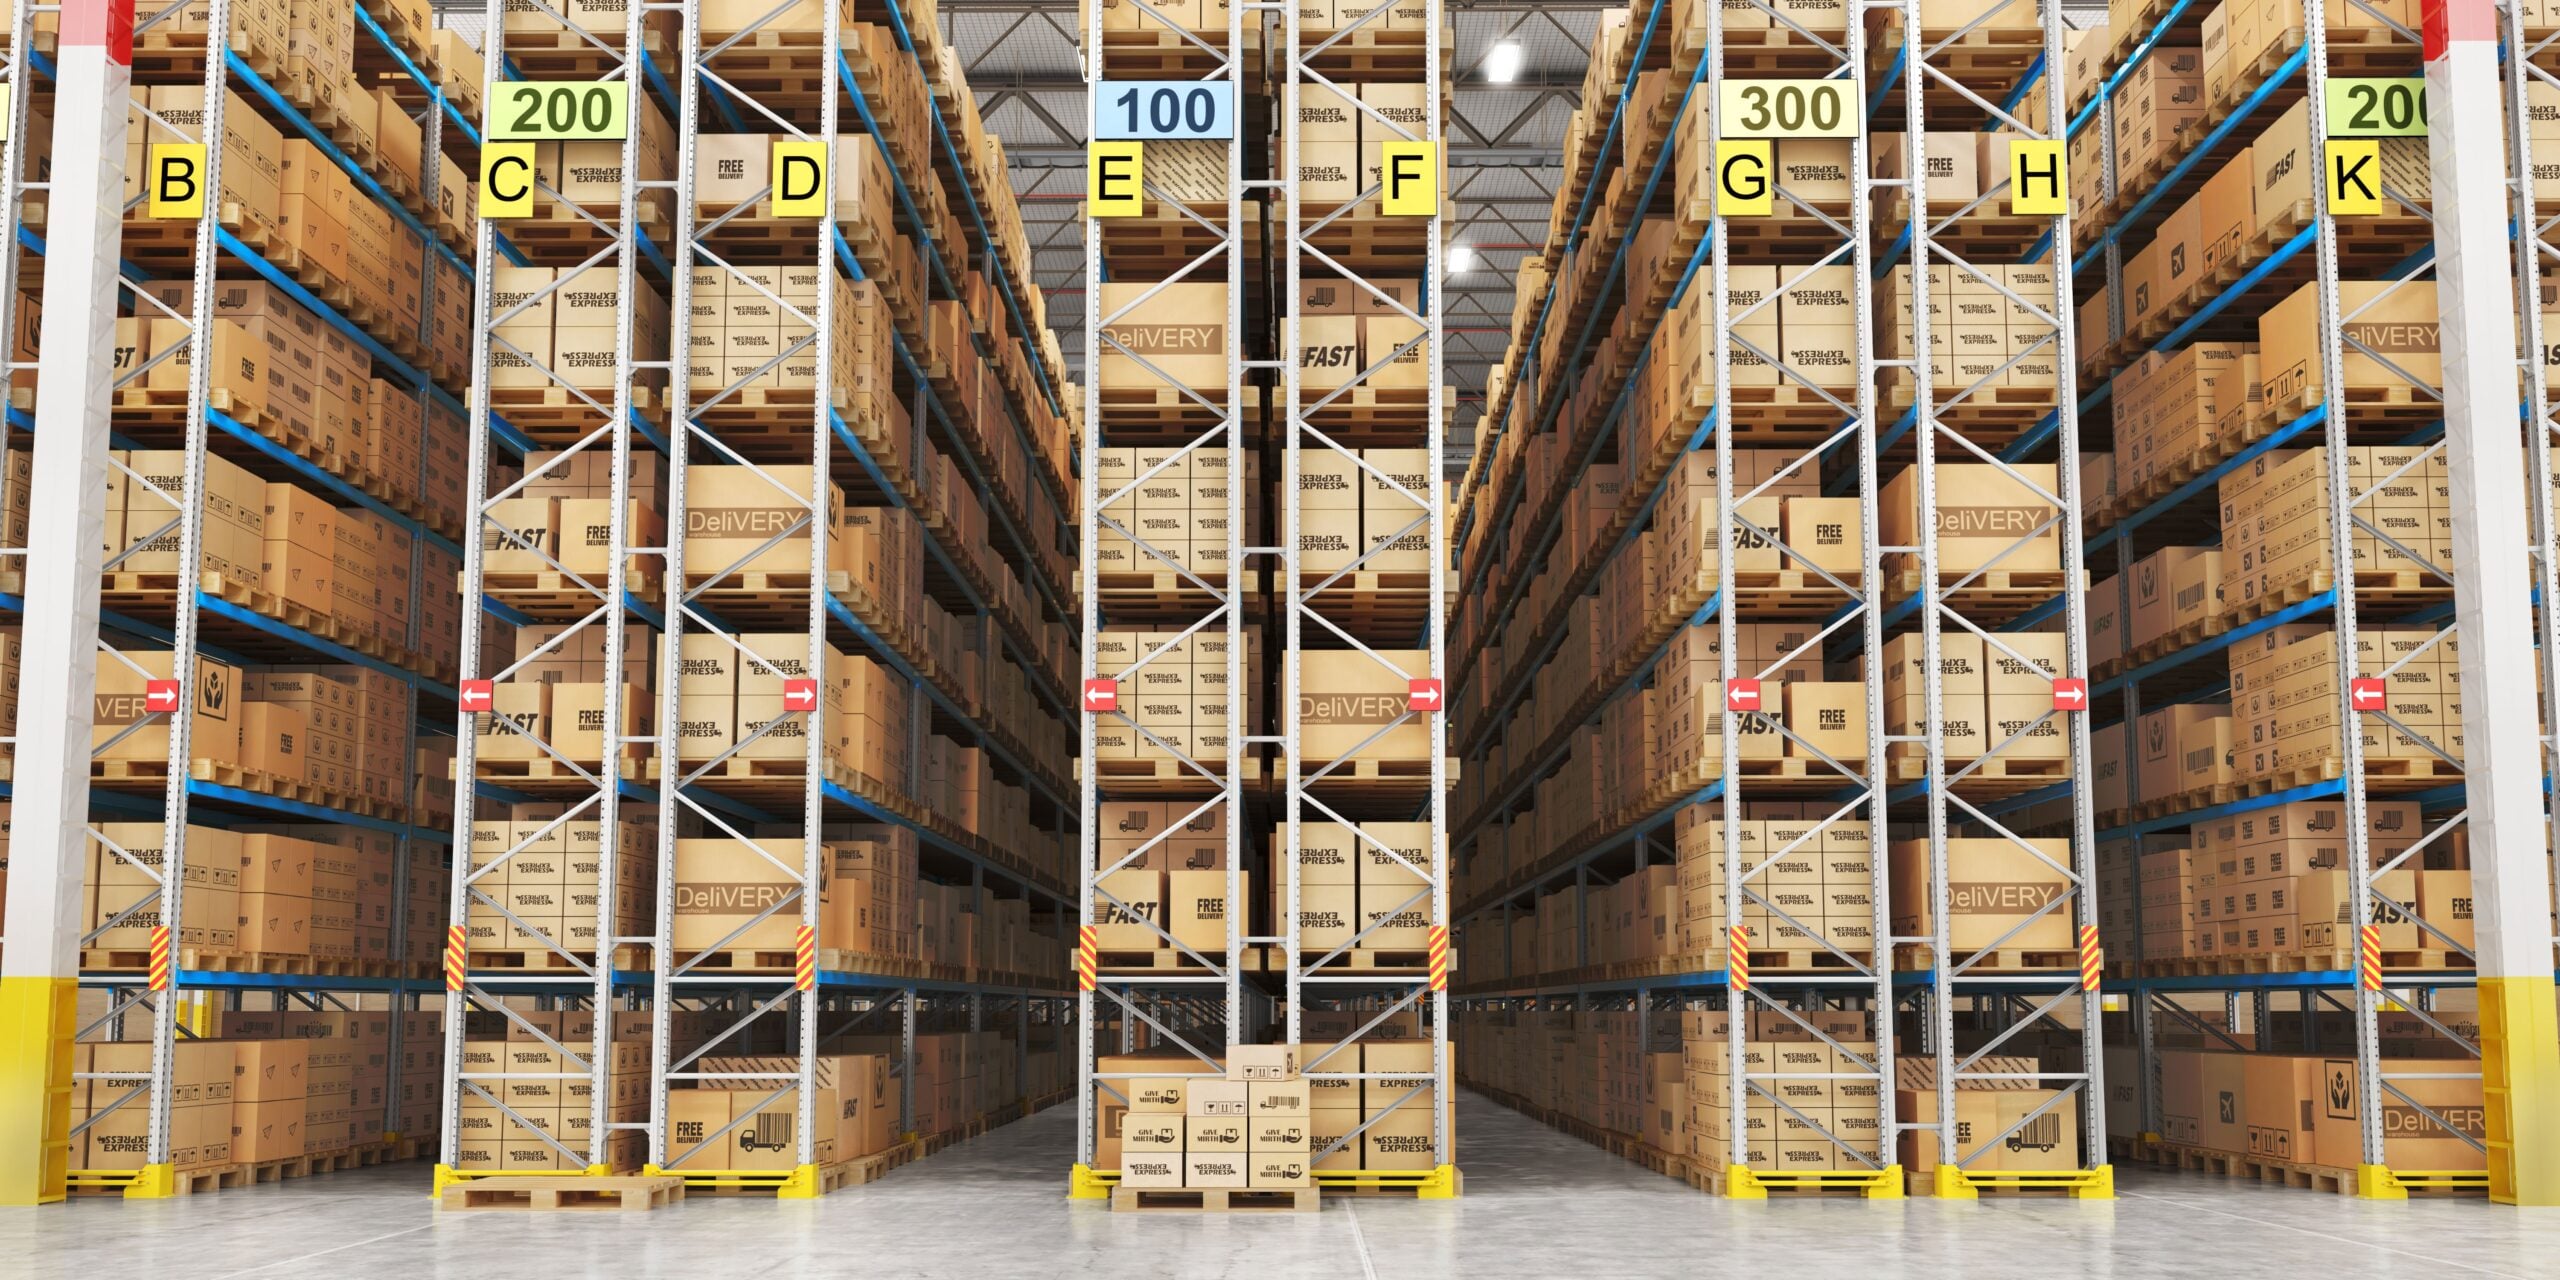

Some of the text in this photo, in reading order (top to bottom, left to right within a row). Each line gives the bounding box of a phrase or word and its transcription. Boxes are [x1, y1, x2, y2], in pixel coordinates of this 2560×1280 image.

[511, 88, 611, 132] 200
[1117, 88, 1215, 133] 100
[1741, 86, 1841, 130] 300
[2348, 85, 2428, 129] 20
[718, 160, 743, 172] FREE
[1928, 158, 1952, 170] FREE
[2275, 149, 2295, 180] FAST
[160, 158, 196, 202] B
[488, 156, 529, 200] C
[782, 156, 820, 200] D
[1099, 155, 1133, 200] E
[1392, 155, 1423, 199] F
[1722, 154, 1765, 200] G
[2020, 153, 2058, 198] H
[2336, 155, 2376, 200] K
[2347, 326, 2439, 346] eliVERY
[1304, 346, 1355, 367] FAST
[690, 511, 802, 531] DeliVERY
[1817, 525, 1842, 537] FREE
[496, 529, 546, 550] FAST
[1300, 697, 1409, 717] DeliVERY
[1820, 710, 1845, 722] FREE
[487, 714, 538, 735] FAST
[677, 887, 793, 907] DeliVERY
[1197, 899, 1223, 912] FREE
[2452, 898, 2472, 912] FRE
[1104, 902, 1157, 924] FAST
[2385, 1110, 2485, 1130] DeliVER
[1381, 1136, 1428, 1144] EXPRESS
